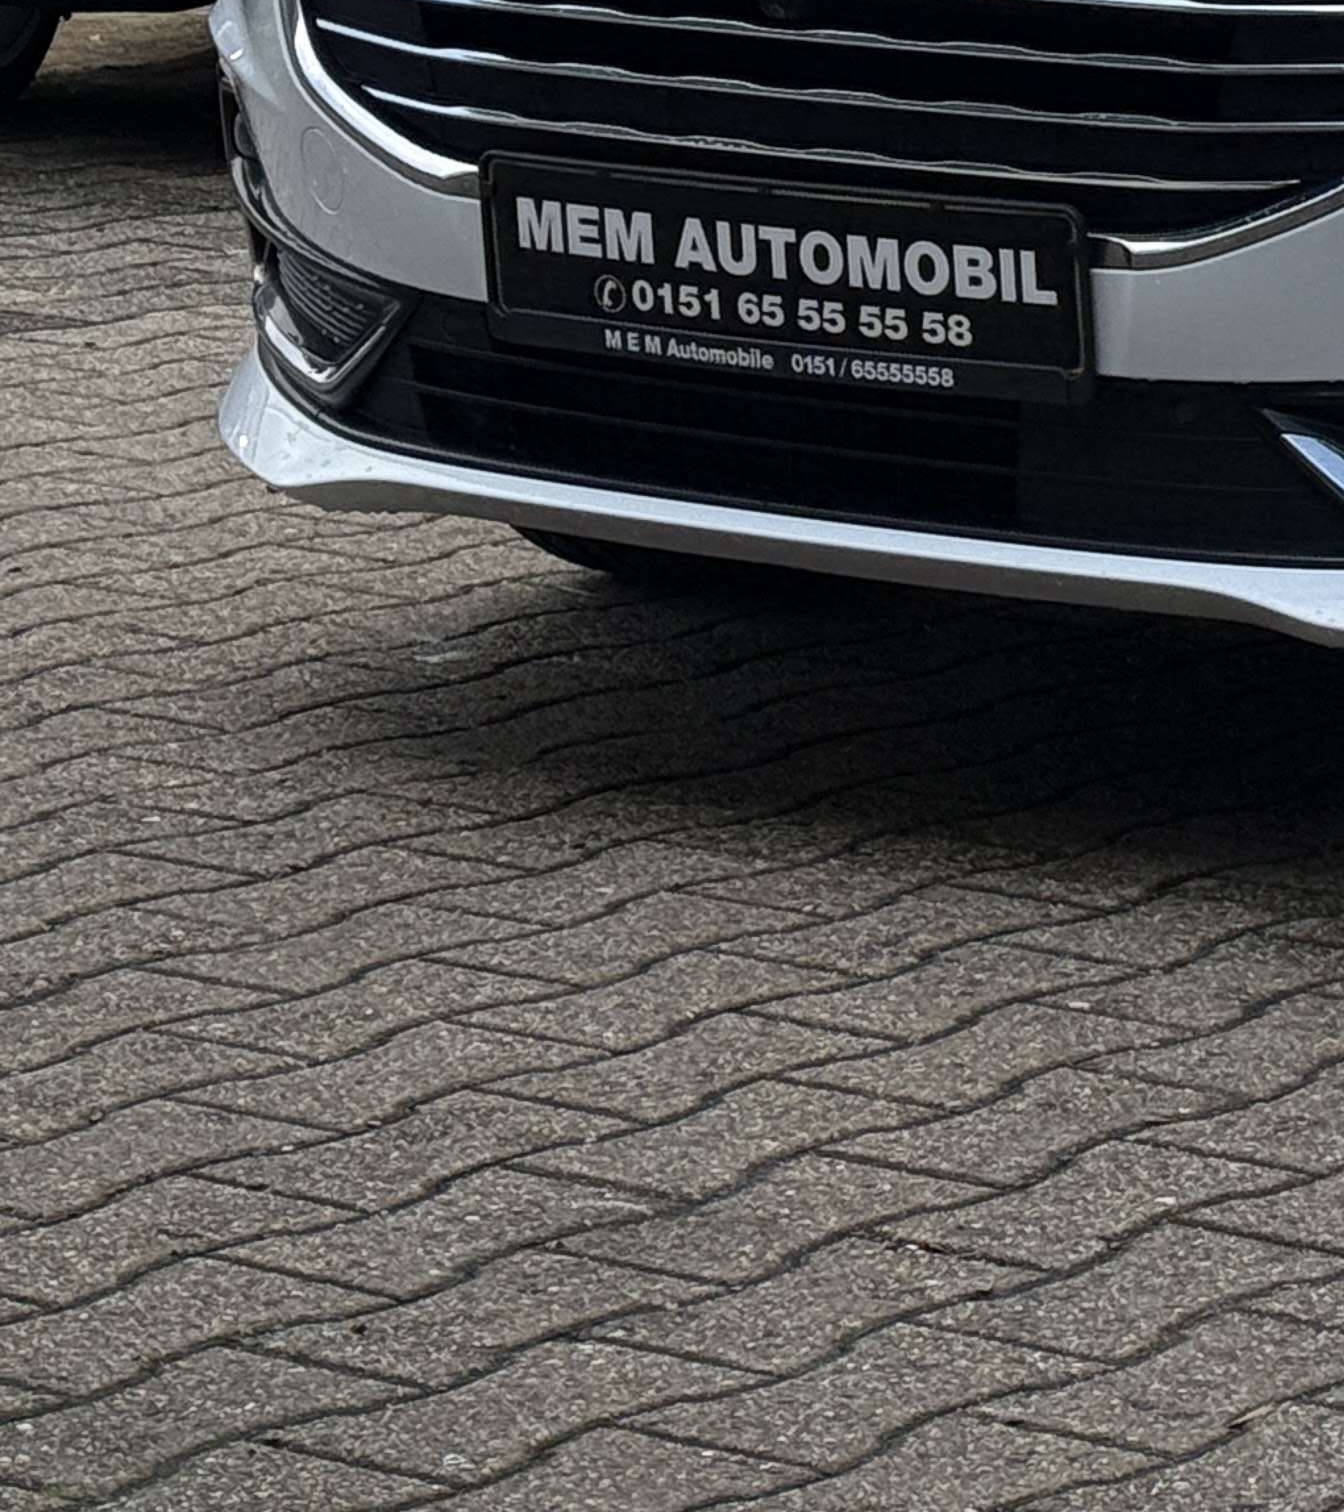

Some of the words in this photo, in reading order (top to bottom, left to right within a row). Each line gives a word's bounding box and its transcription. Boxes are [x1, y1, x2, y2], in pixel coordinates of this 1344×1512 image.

[516, 196, 655, 265] MEM
[674, 217, 1058, 306] AUTOMOBIL
[631, 279, 721, 320] 0151
[737, 292, 785, 327] 65
[797, 298, 846, 334] 55
[858, 304, 908, 340] 55
[922, 311, 973, 347] 58
[604, 329, 622, 350] M
[627, 333, 640, 352] E
[645, 335, 662, 356] M
[666, 338, 774, 370] Automobile
[791, 353, 835, 377] 0151
[838, 357, 848, 377] /
[851, 359, 954, 388] 65555558
